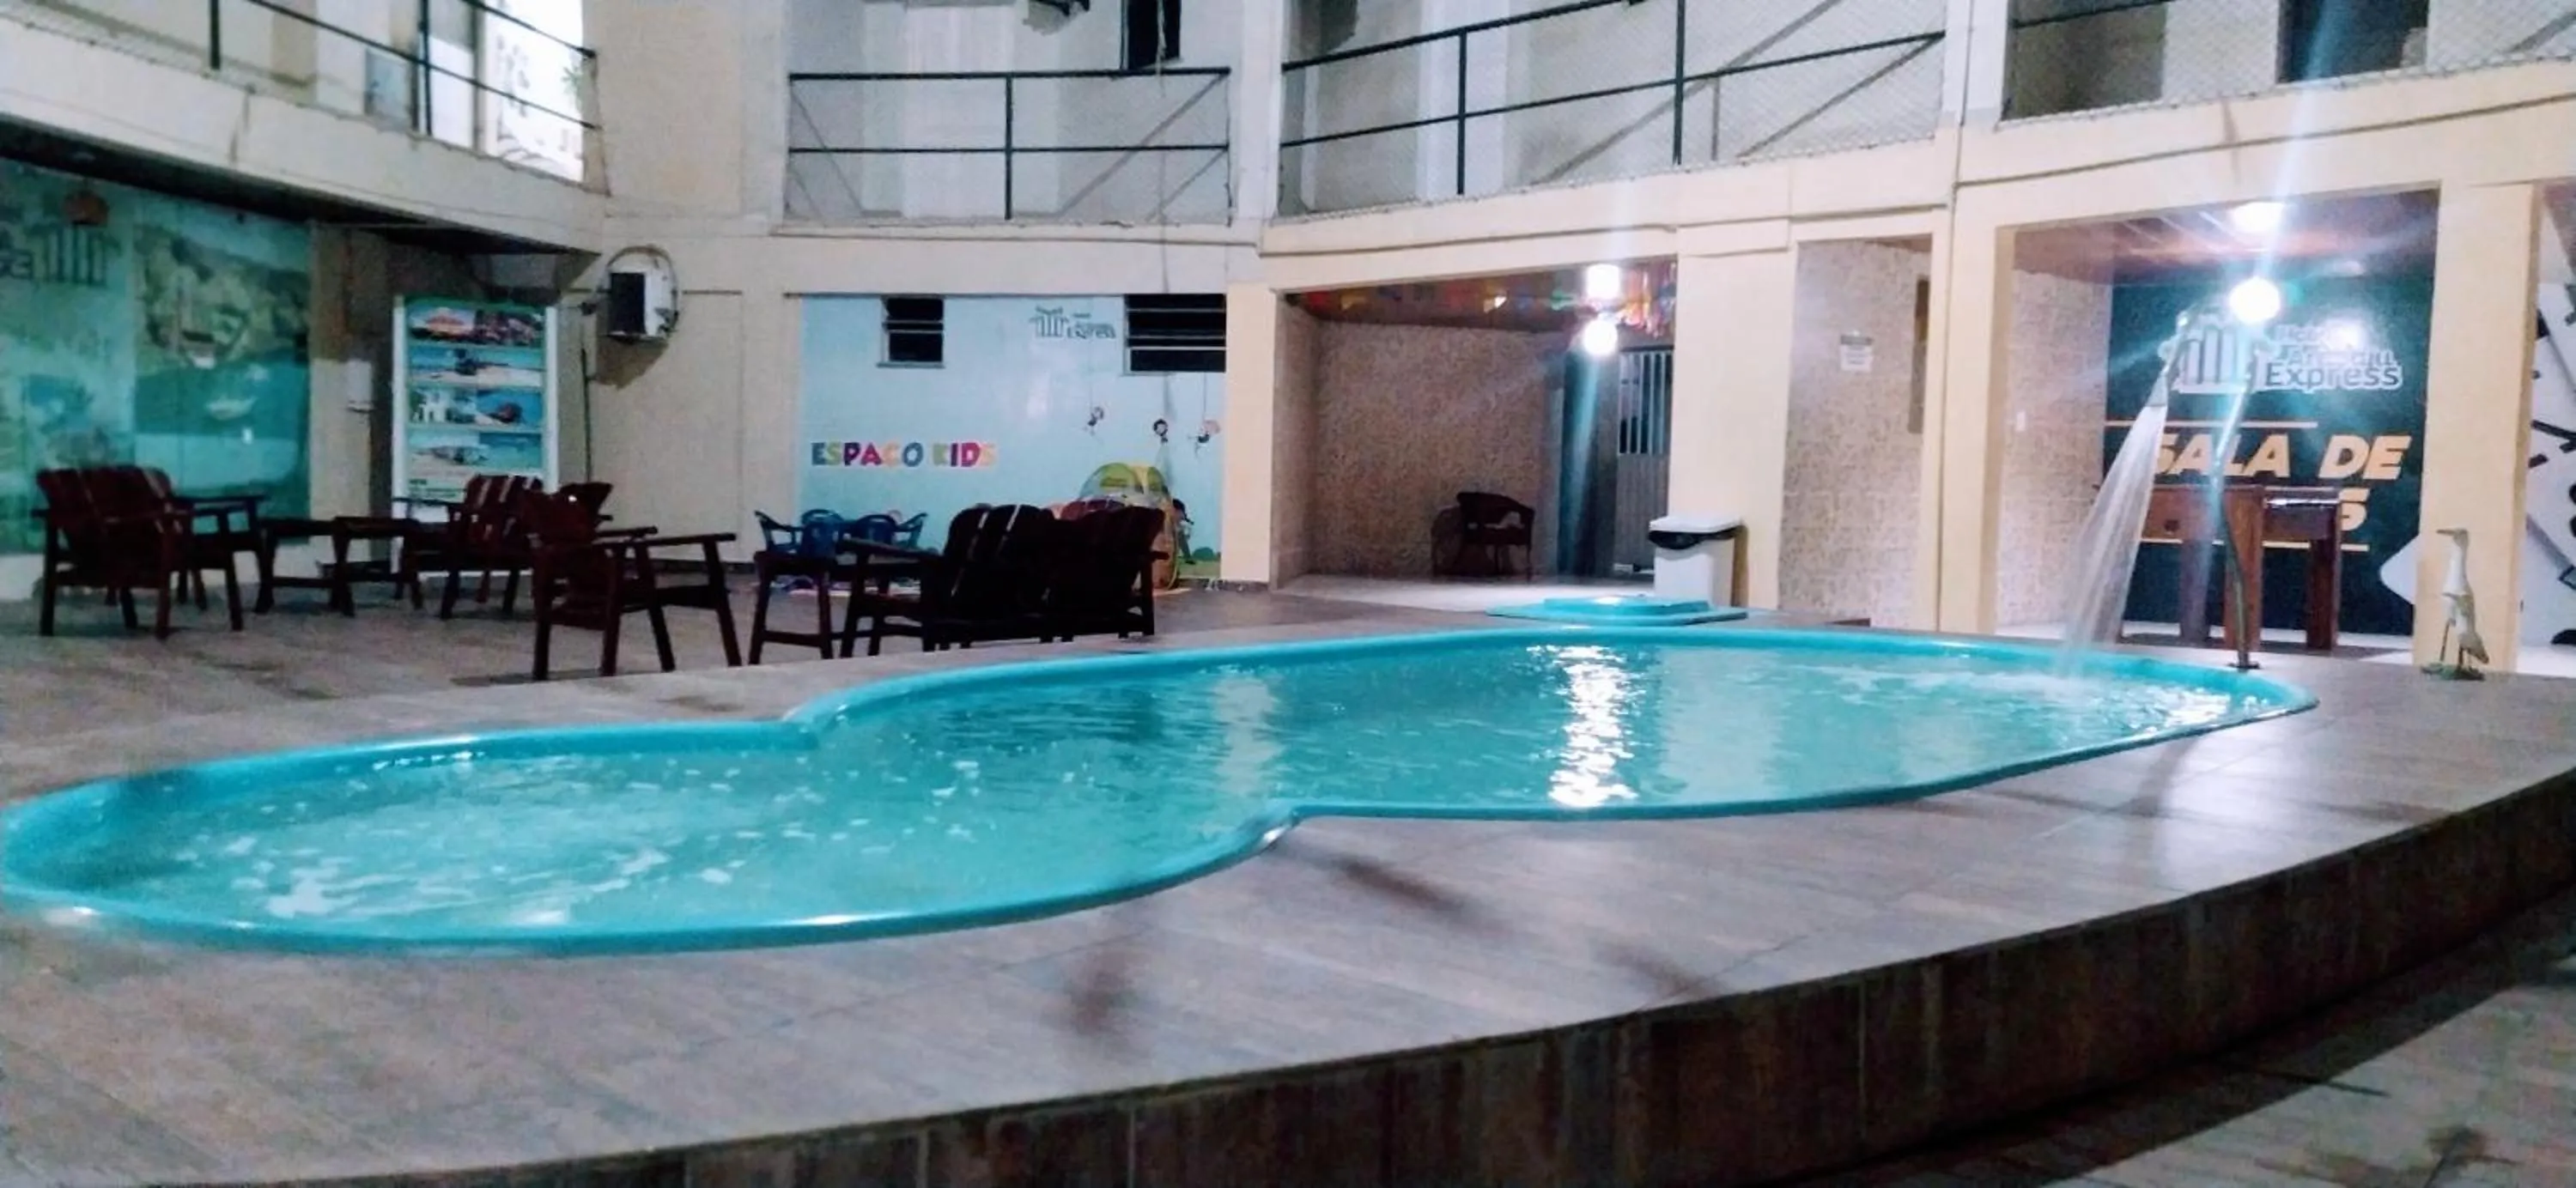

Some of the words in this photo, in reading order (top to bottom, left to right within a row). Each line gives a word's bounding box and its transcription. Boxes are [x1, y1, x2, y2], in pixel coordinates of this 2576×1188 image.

[2266, 361, 2401, 391] Express
[932, 441, 996, 468] KIDS
[2156, 433, 2290, 476] SALA
[2318, 434, 2413, 480] DE
